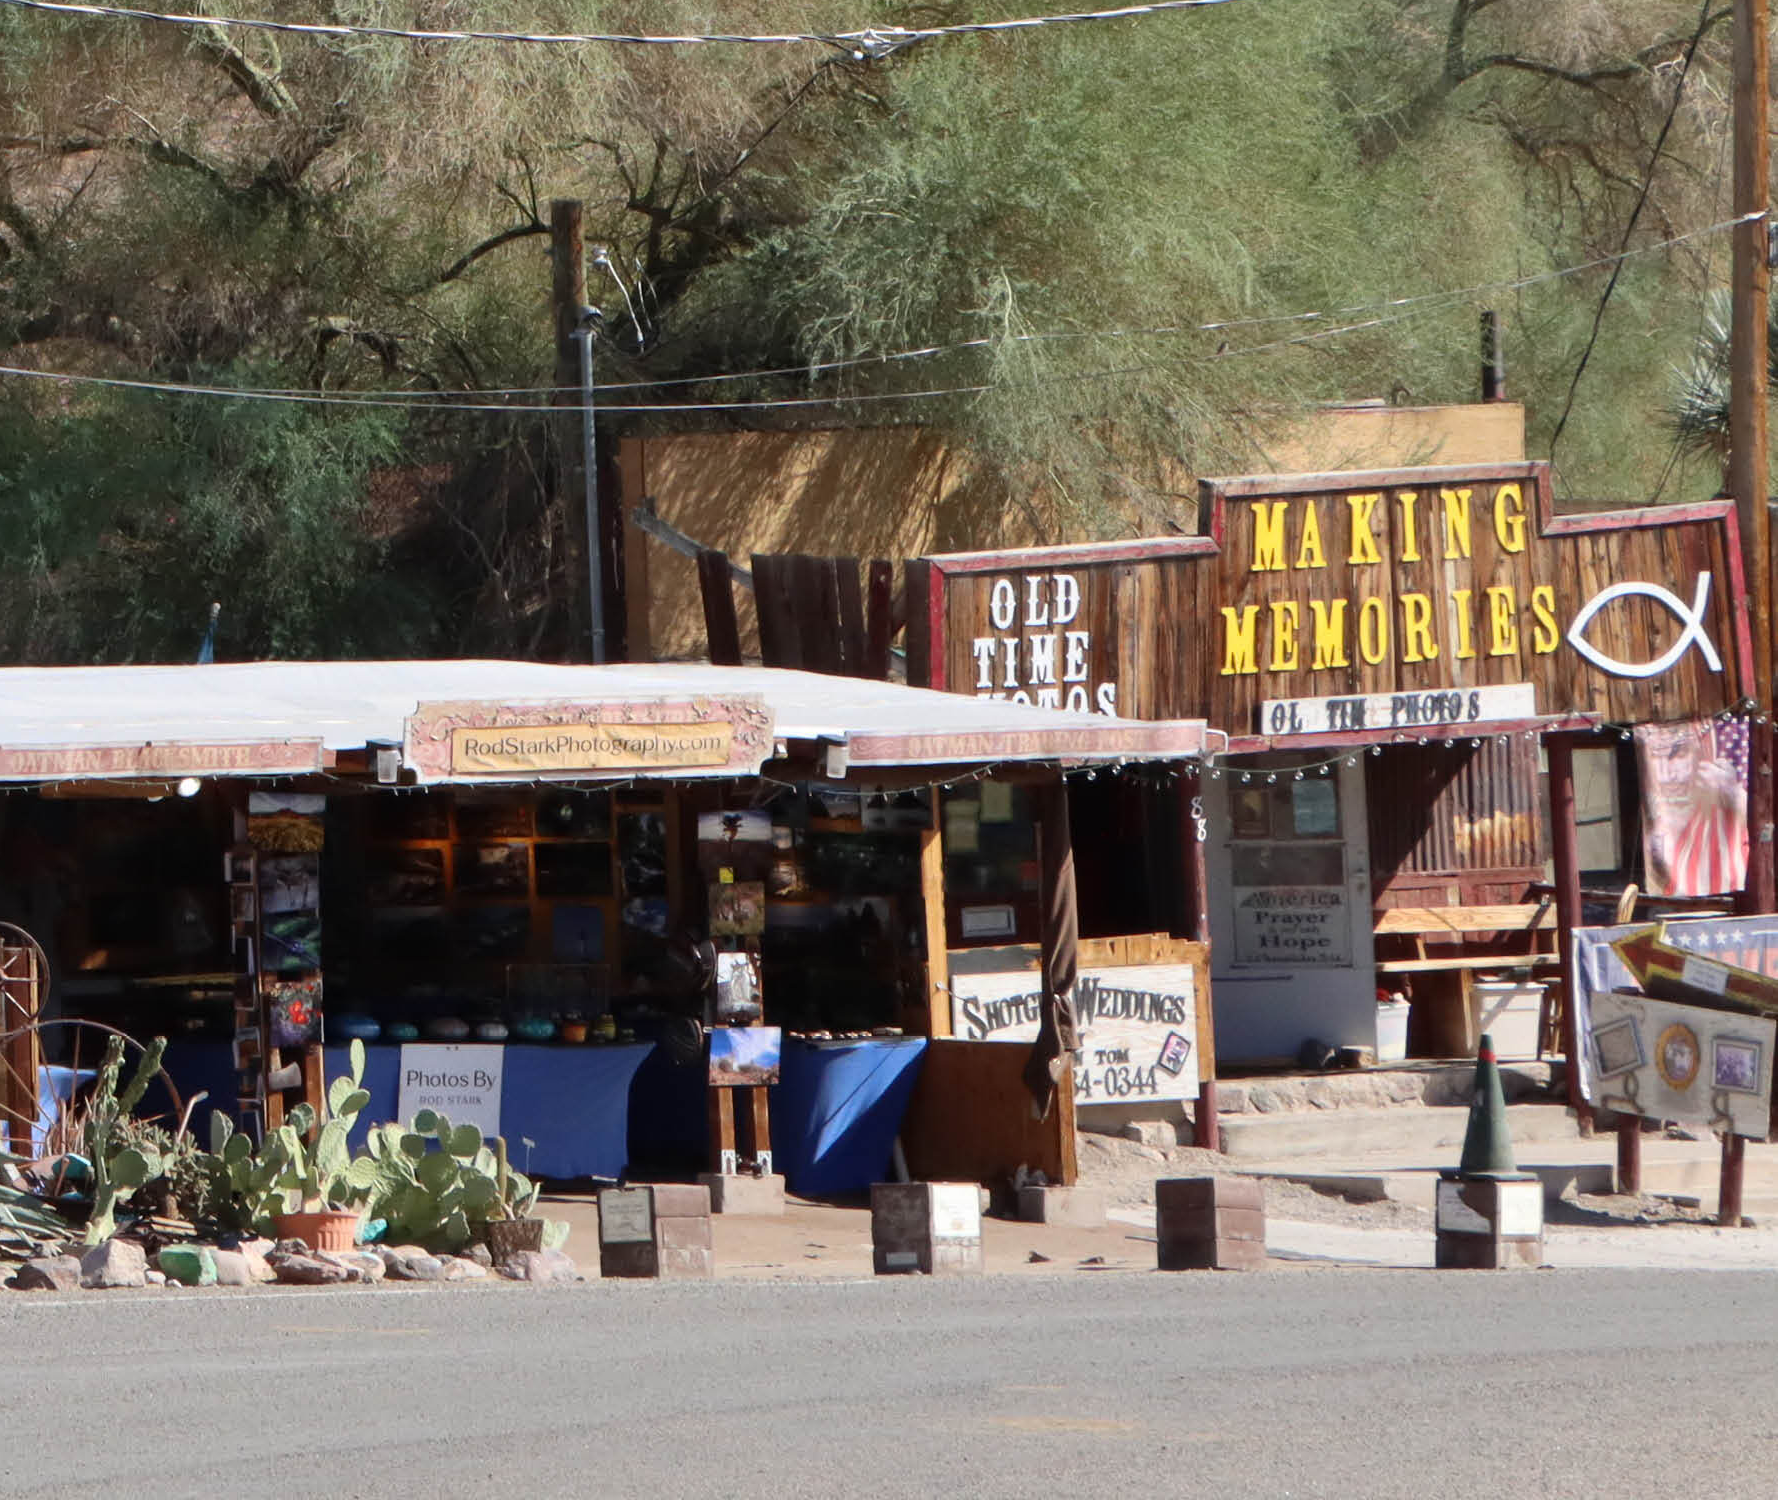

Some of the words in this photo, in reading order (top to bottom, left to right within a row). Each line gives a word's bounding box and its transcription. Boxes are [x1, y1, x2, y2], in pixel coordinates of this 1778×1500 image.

[1251, 484, 1526, 572] MAKING
[989, 574, 1081, 629] OLD
[1221, 585, 1560, 676] MEMORIES
[973, 631, 1090, 688] TIME
[465, 733, 722, 758] RodStarkPhotography.com
[11, 750, 103, 774] OATMAN
[112, 745, 252, 771] BLACKSMITH
[1253, 910, 1330, 926] Prayer
[1259, 933, 1331, 951] Hope
[962, 990, 1045, 1041] SHOTG
[1072, 976, 1186, 1026] WEDDINGS
[1095, 1048, 1130, 1066] TOM
[406, 1069, 469, 1088] Photos
[473, 1069, 497, 1092] By
[418, 1095, 444, 1106] ROD
[447, 1094, 483, 1106] STARK
